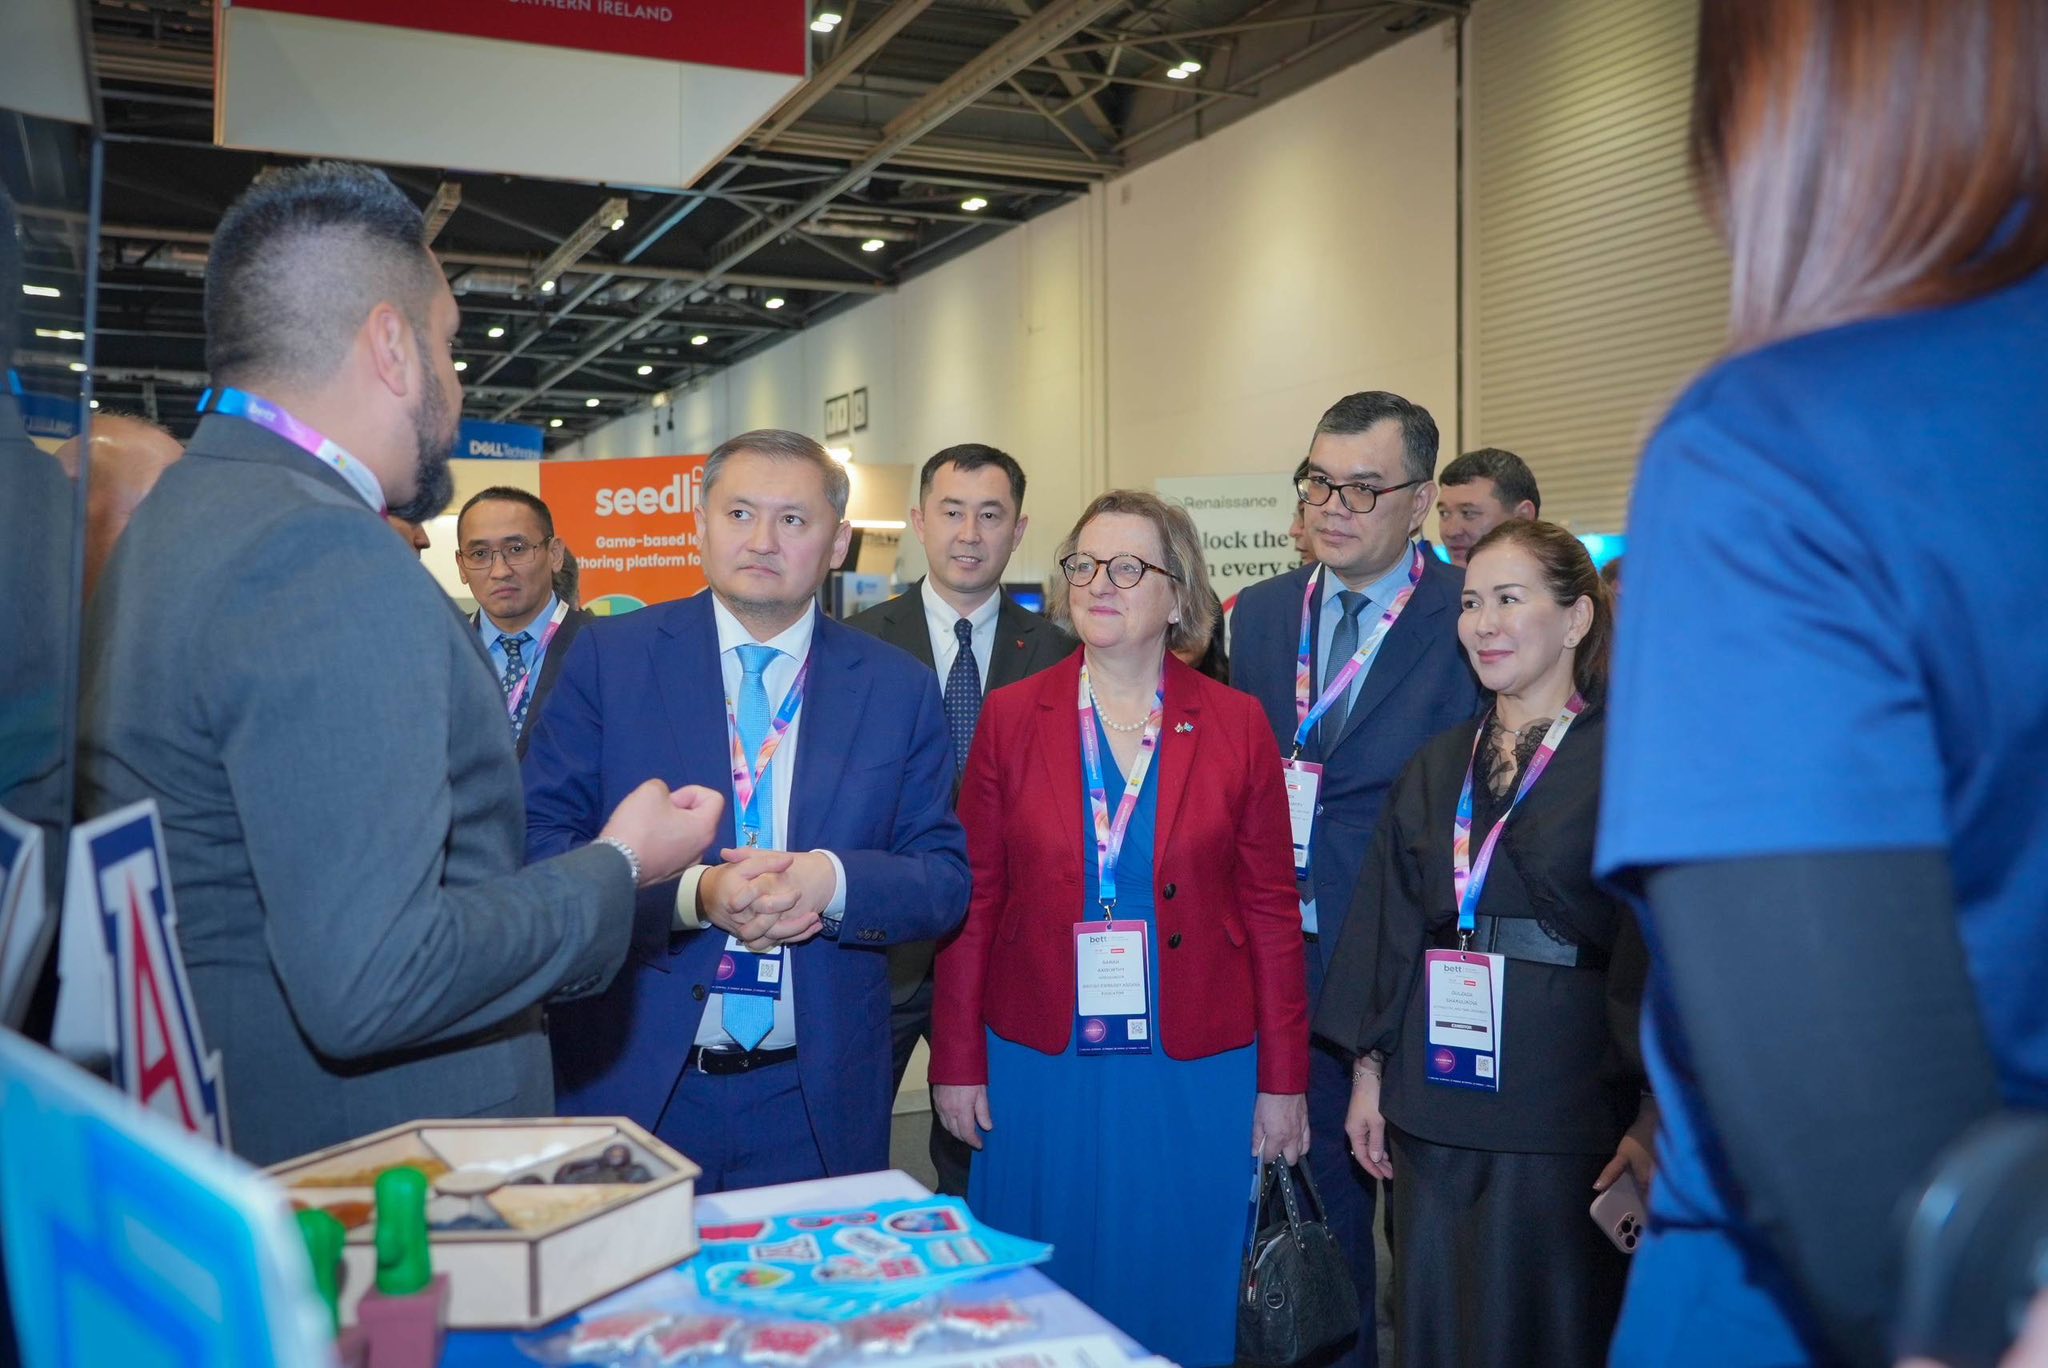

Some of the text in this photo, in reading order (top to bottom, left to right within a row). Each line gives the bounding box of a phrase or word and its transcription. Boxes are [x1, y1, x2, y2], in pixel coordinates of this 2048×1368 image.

[597, 1, 672, 22] IRELAND
[470, 440, 503, 458] DELL
[1184, 496, 1277, 510] Renaissance
[596, 532, 685, 549] Game-based
[1203, 530, 1289, 549] lock the
[626, 552, 685, 572] platform
[1222, 563, 1282, 577] every
[1090, 936, 1107, 944] bett
[1444, 965, 1462, 973] bett
